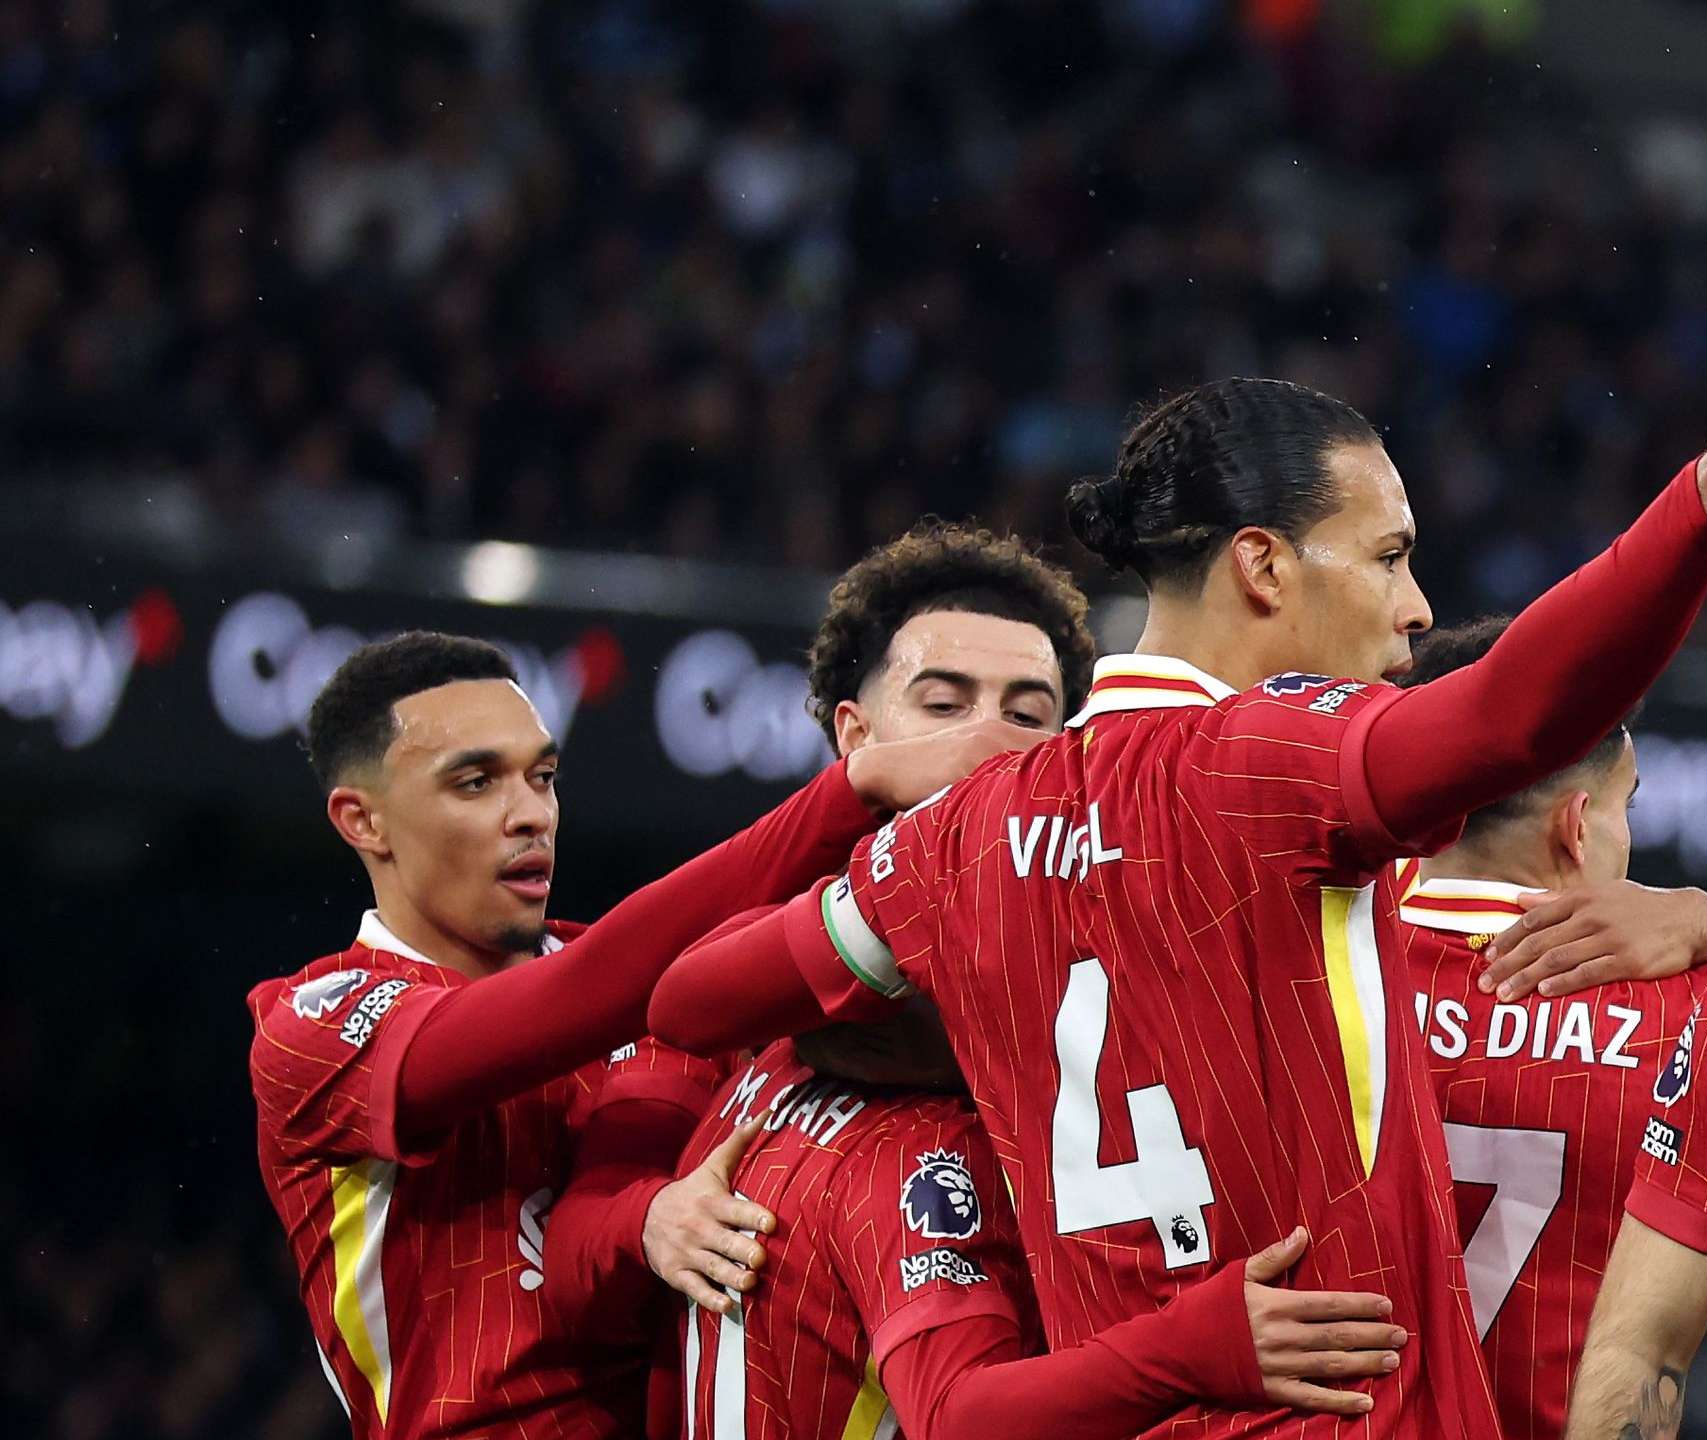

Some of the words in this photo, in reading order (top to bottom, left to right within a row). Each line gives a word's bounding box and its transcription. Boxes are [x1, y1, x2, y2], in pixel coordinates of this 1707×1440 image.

[1486, 1001, 1643, 1068] DIAZ
[1052, 957, 1215, 1270] 4
[900, 1255, 930, 1276] No
[931, 1249, 975, 1275] room
[1443, 1122, 1567, 1345] 7
[902, 1268, 930, 1293] for
